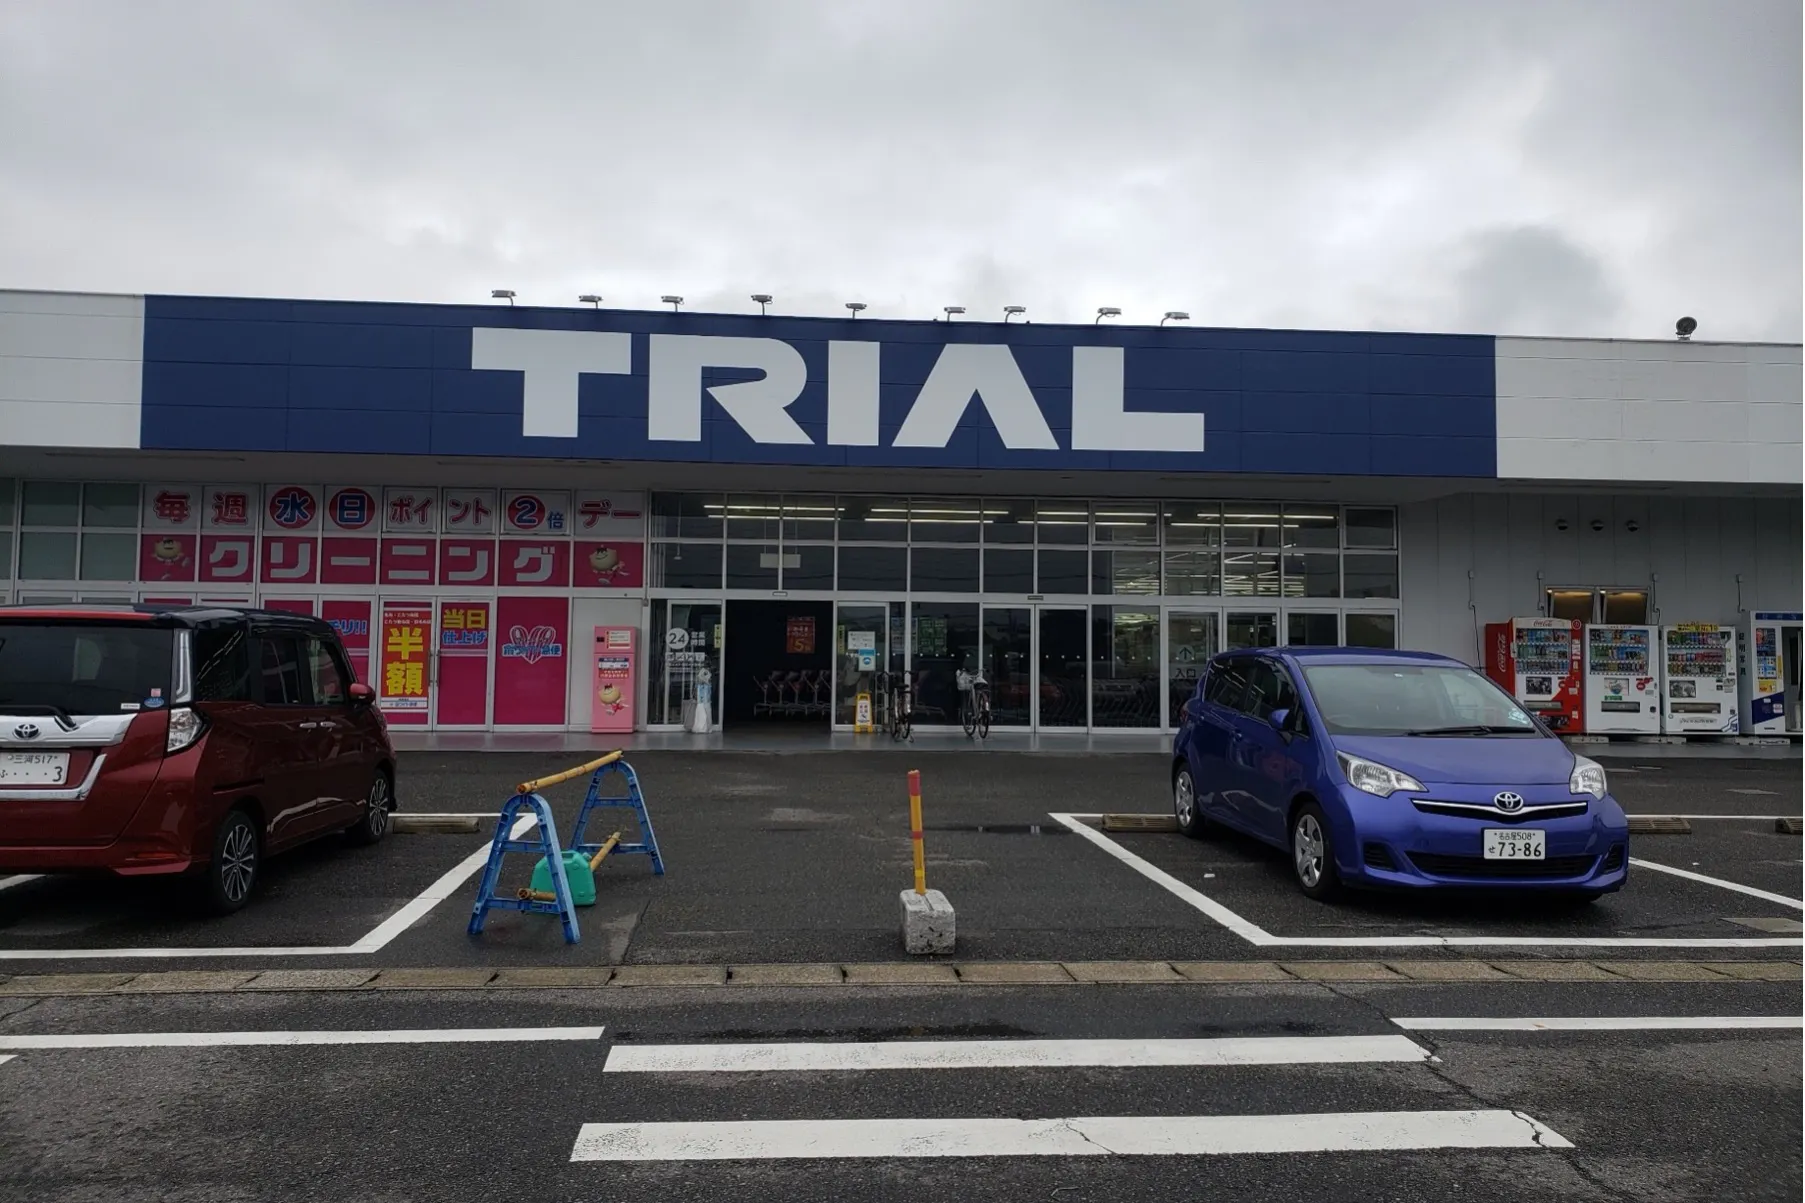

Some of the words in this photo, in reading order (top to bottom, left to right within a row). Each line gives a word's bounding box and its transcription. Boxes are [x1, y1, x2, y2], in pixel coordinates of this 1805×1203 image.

[472, 327, 1204, 452] TRIAL
[209, 540, 556, 582] クリーニング
[442, 608, 486, 629] 当日
[442, 630, 488, 646] 仕上げ
[669, 632, 685, 645] 24
[387, 626, 424, 695] 半額
[1175, 668, 1197, 678] 入口
[1498, 842, 1542, 857] 73-86
